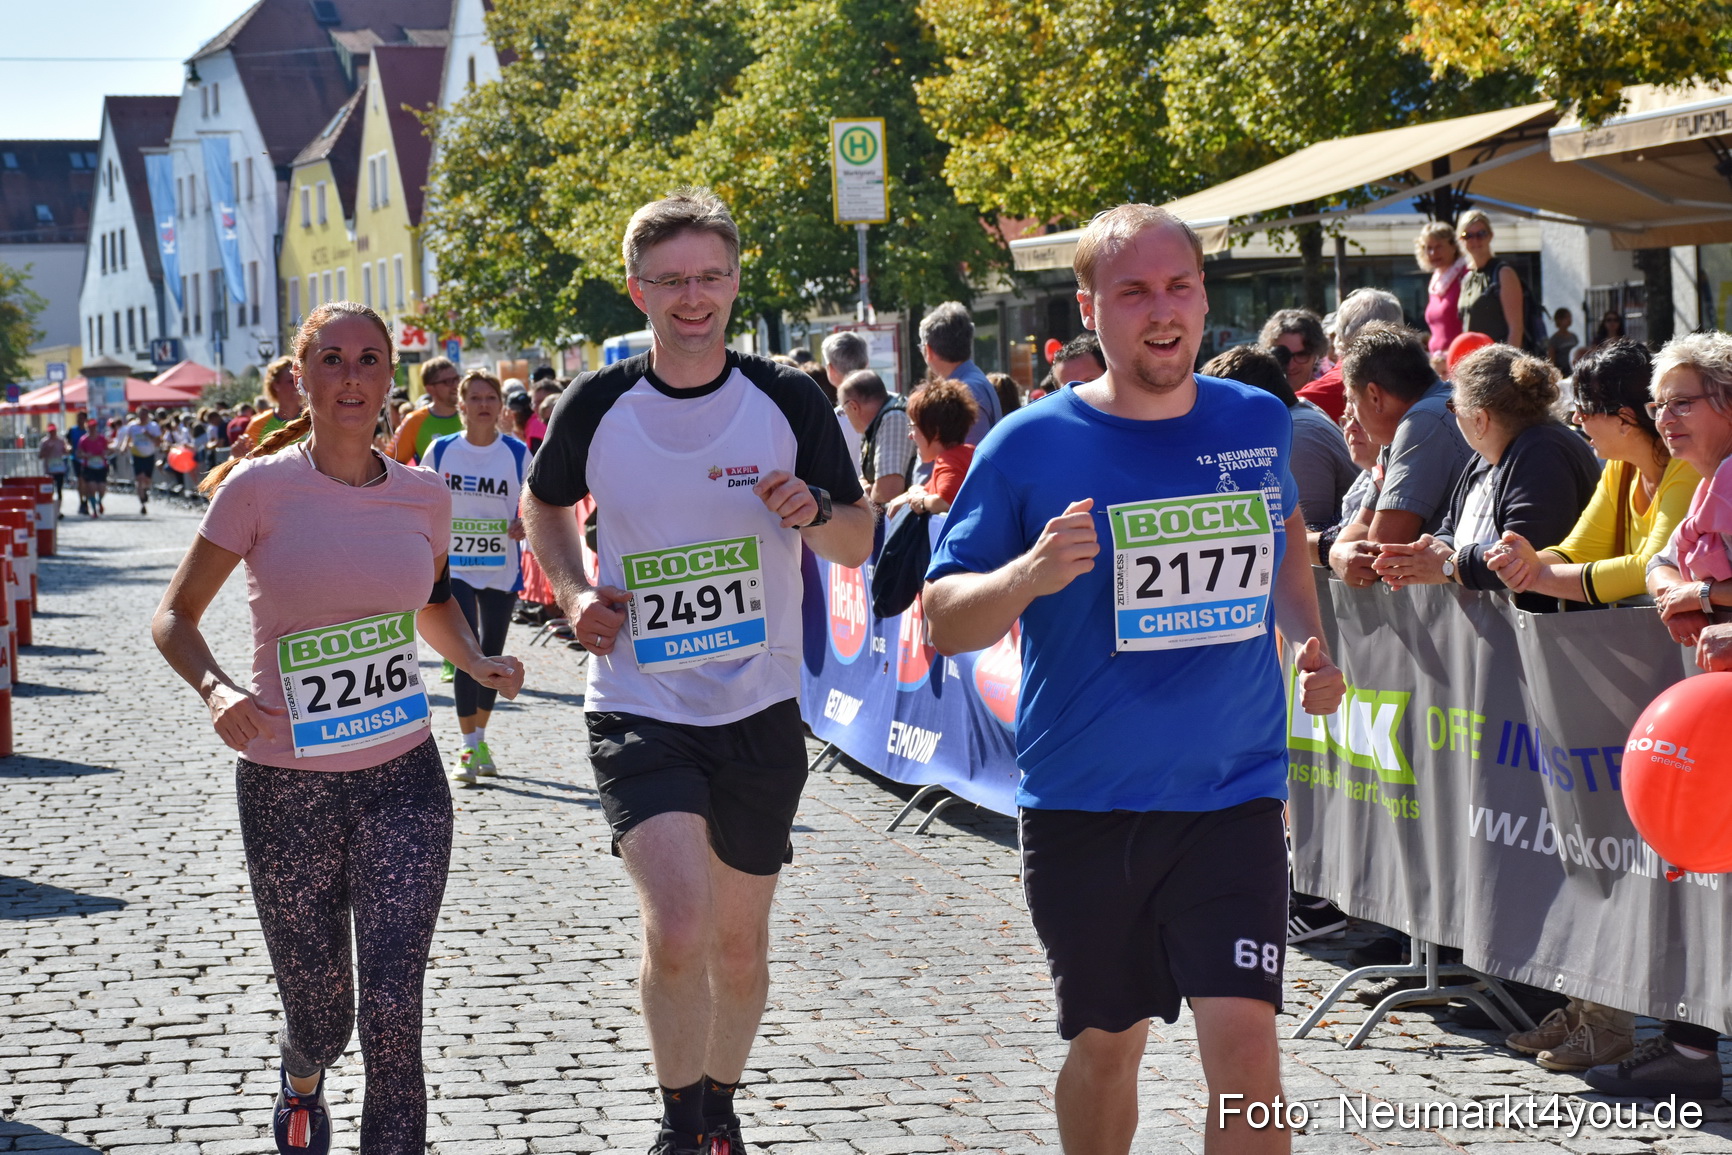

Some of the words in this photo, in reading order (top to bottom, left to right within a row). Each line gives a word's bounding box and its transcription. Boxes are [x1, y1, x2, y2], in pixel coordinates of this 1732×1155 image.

[849, 135, 868, 157] H
[1196, 455, 1217, 466] 12.
[1217, 447, 1278, 463] NEUMARKTER
[1218, 457, 1273, 472] STADTLAUF
[728, 476, 759, 488] Daniel
[452, 521, 502, 532] BOCK
[1123, 499, 1260, 543] BOCK
[453, 536, 501, 553] 2796
[632, 541, 750, 584] BOCK
[1136, 545, 1257, 599] 2177
[643, 579, 745, 631] 2491
[831, 563, 866, 635] Hervis
[1139, 604, 1257, 633] CHRISTOF
[288, 615, 406, 667] BOCK
[665, 630, 739, 656] DANIEL
[301, 654, 407, 713] 2246
[321, 706, 408, 741] LARISSA
[1651, 755, 1692, 772] energie
[1235, 938, 1279, 975] 68
